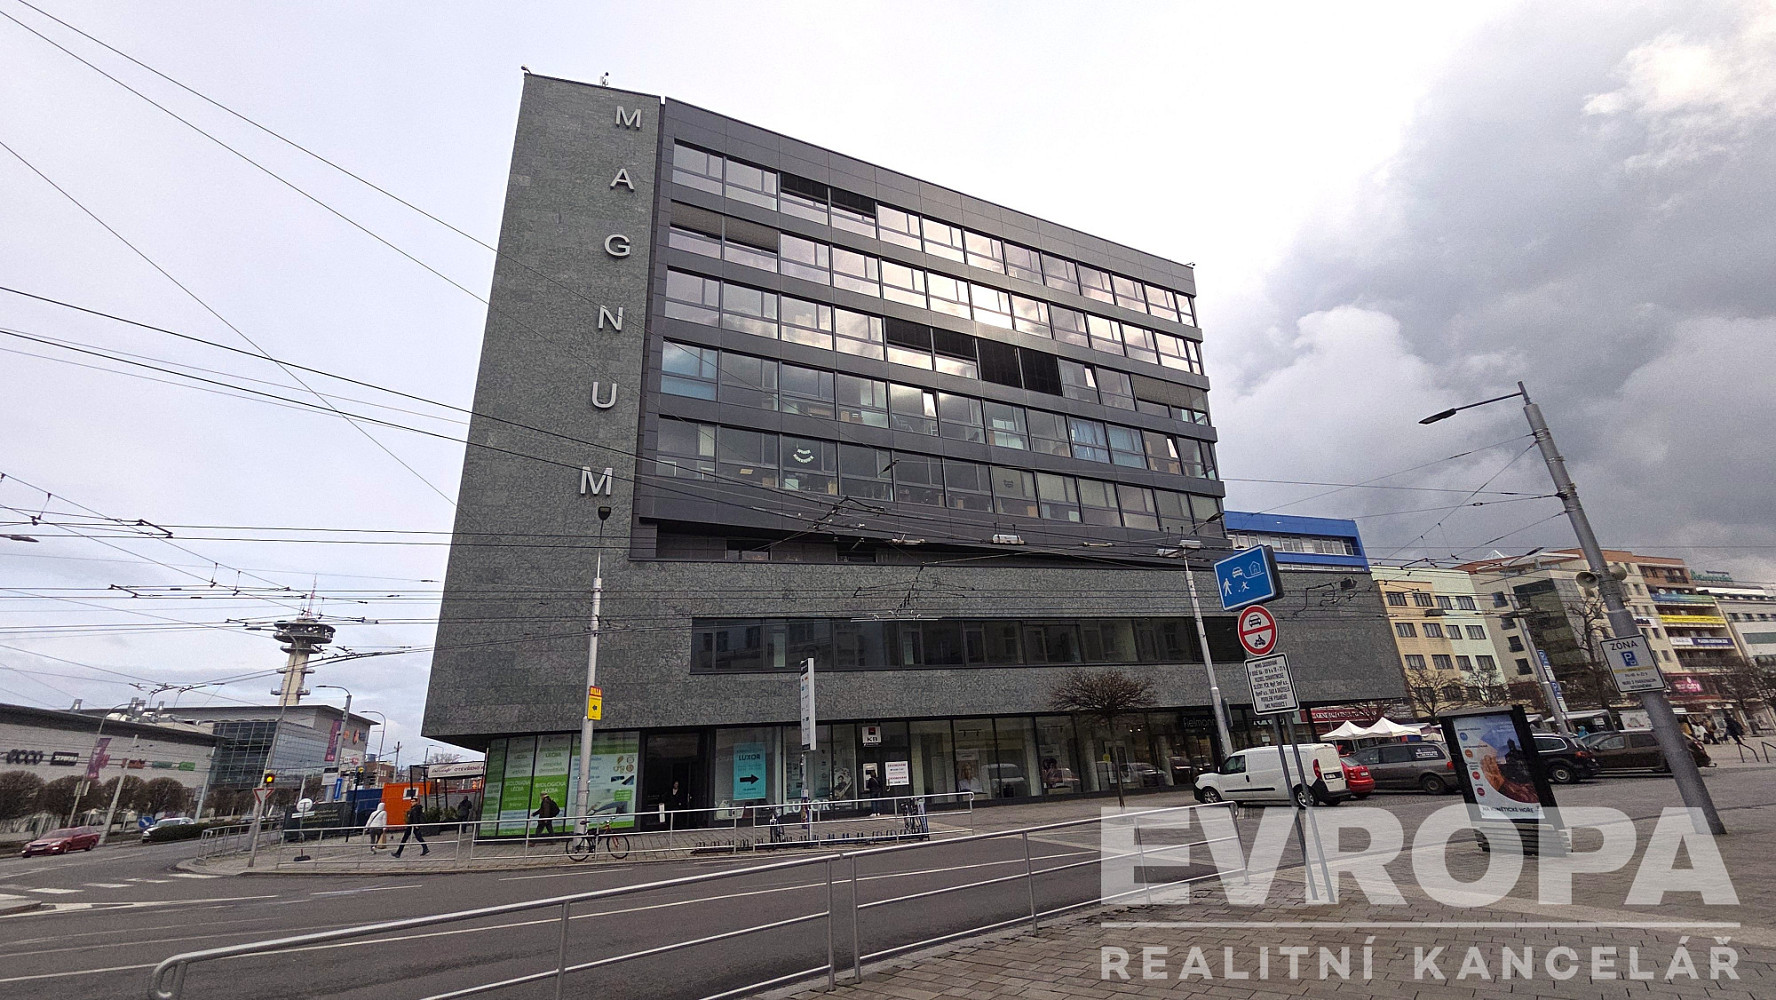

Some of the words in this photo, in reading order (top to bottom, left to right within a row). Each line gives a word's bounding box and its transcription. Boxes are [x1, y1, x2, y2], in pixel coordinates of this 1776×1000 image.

[581, 105, 642, 497] MAGNUM
[1609, 640, 1639, 651] ZÓNA
[739, 753, 761, 761] LUXOR
